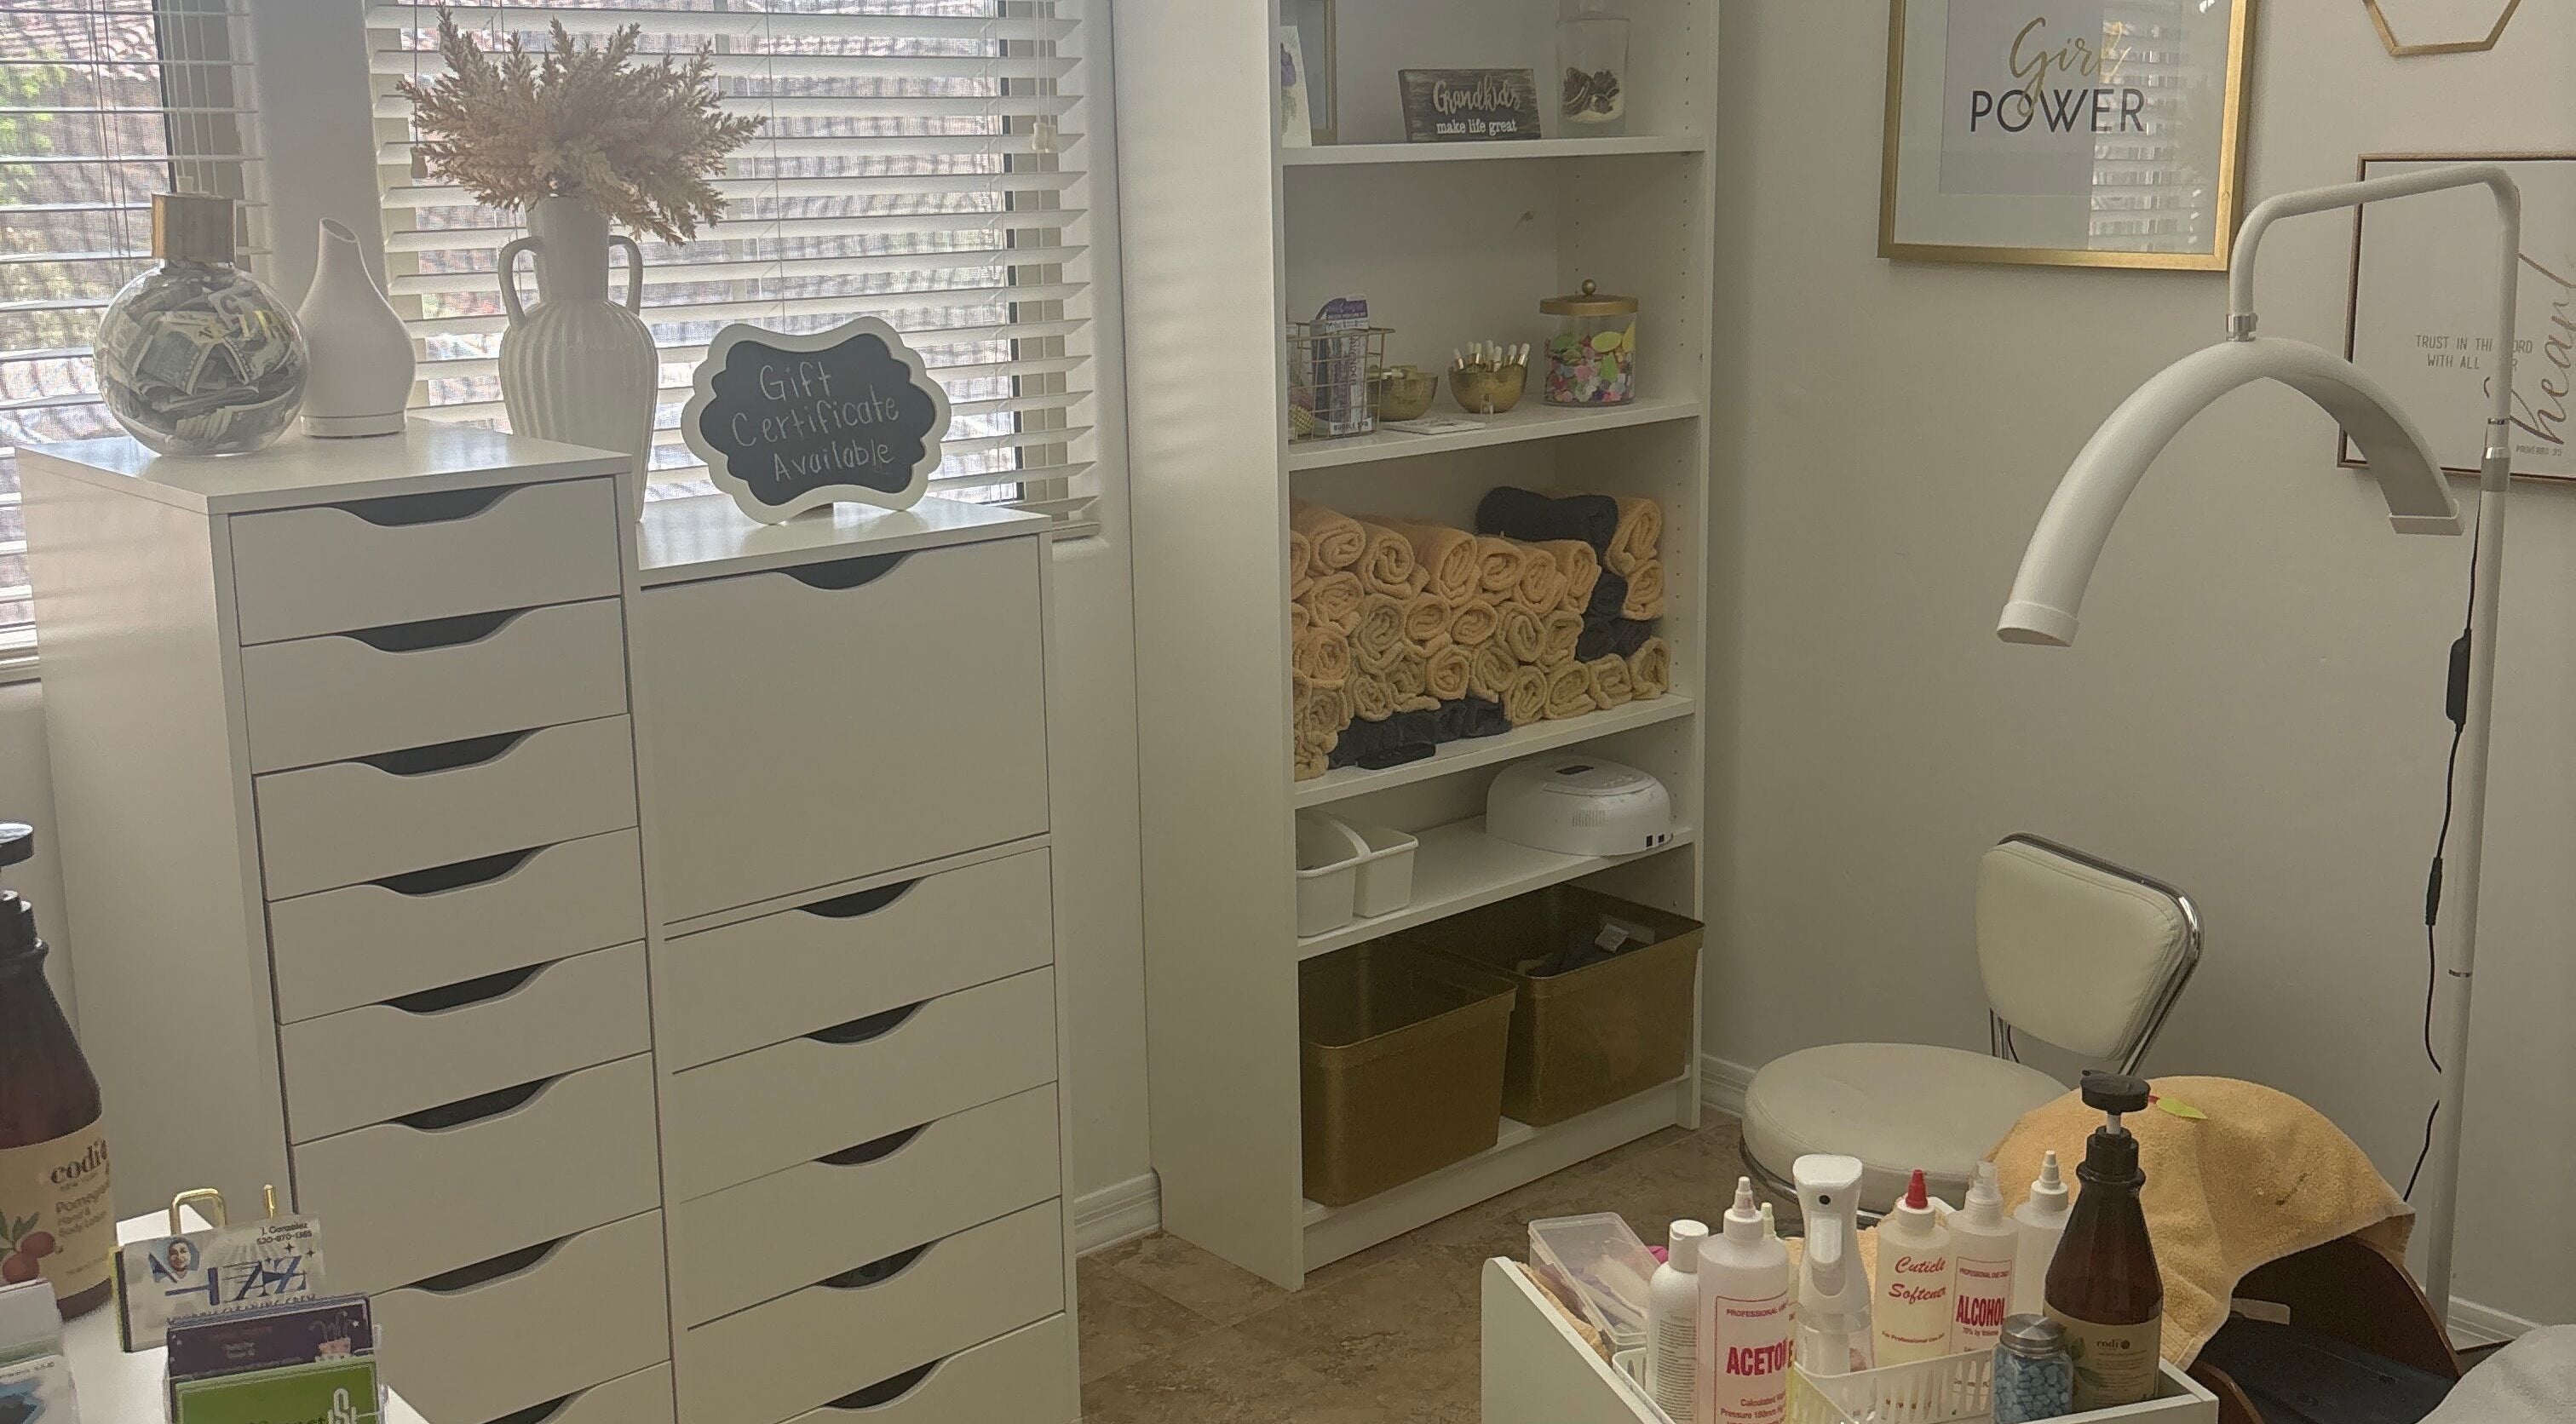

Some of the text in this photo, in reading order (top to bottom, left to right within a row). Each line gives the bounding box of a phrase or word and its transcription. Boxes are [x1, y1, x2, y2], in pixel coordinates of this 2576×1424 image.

[2010, 16, 2131, 118] Girl
[1433, 74, 1521, 116] Grandkids
[1970, 88, 2145, 133] POWER
[1436, 118, 1517, 136] make life great
[2415, 335, 2450, 350] TRUST
[2457, 335, 2468, 351] IN
[759, 360, 832, 401] Gift
[2428, 354, 2481, 370] WITH ALL
[731, 384, 900, 447] Certificate
[773, 438, 894, 481] Available
[1726, 1306, 1778, 1318] PROFESSIONAL
[1955, 1295, 2006, 1328] ALCOHOL
[1721, 1407, 1752, 1420] Pressure
